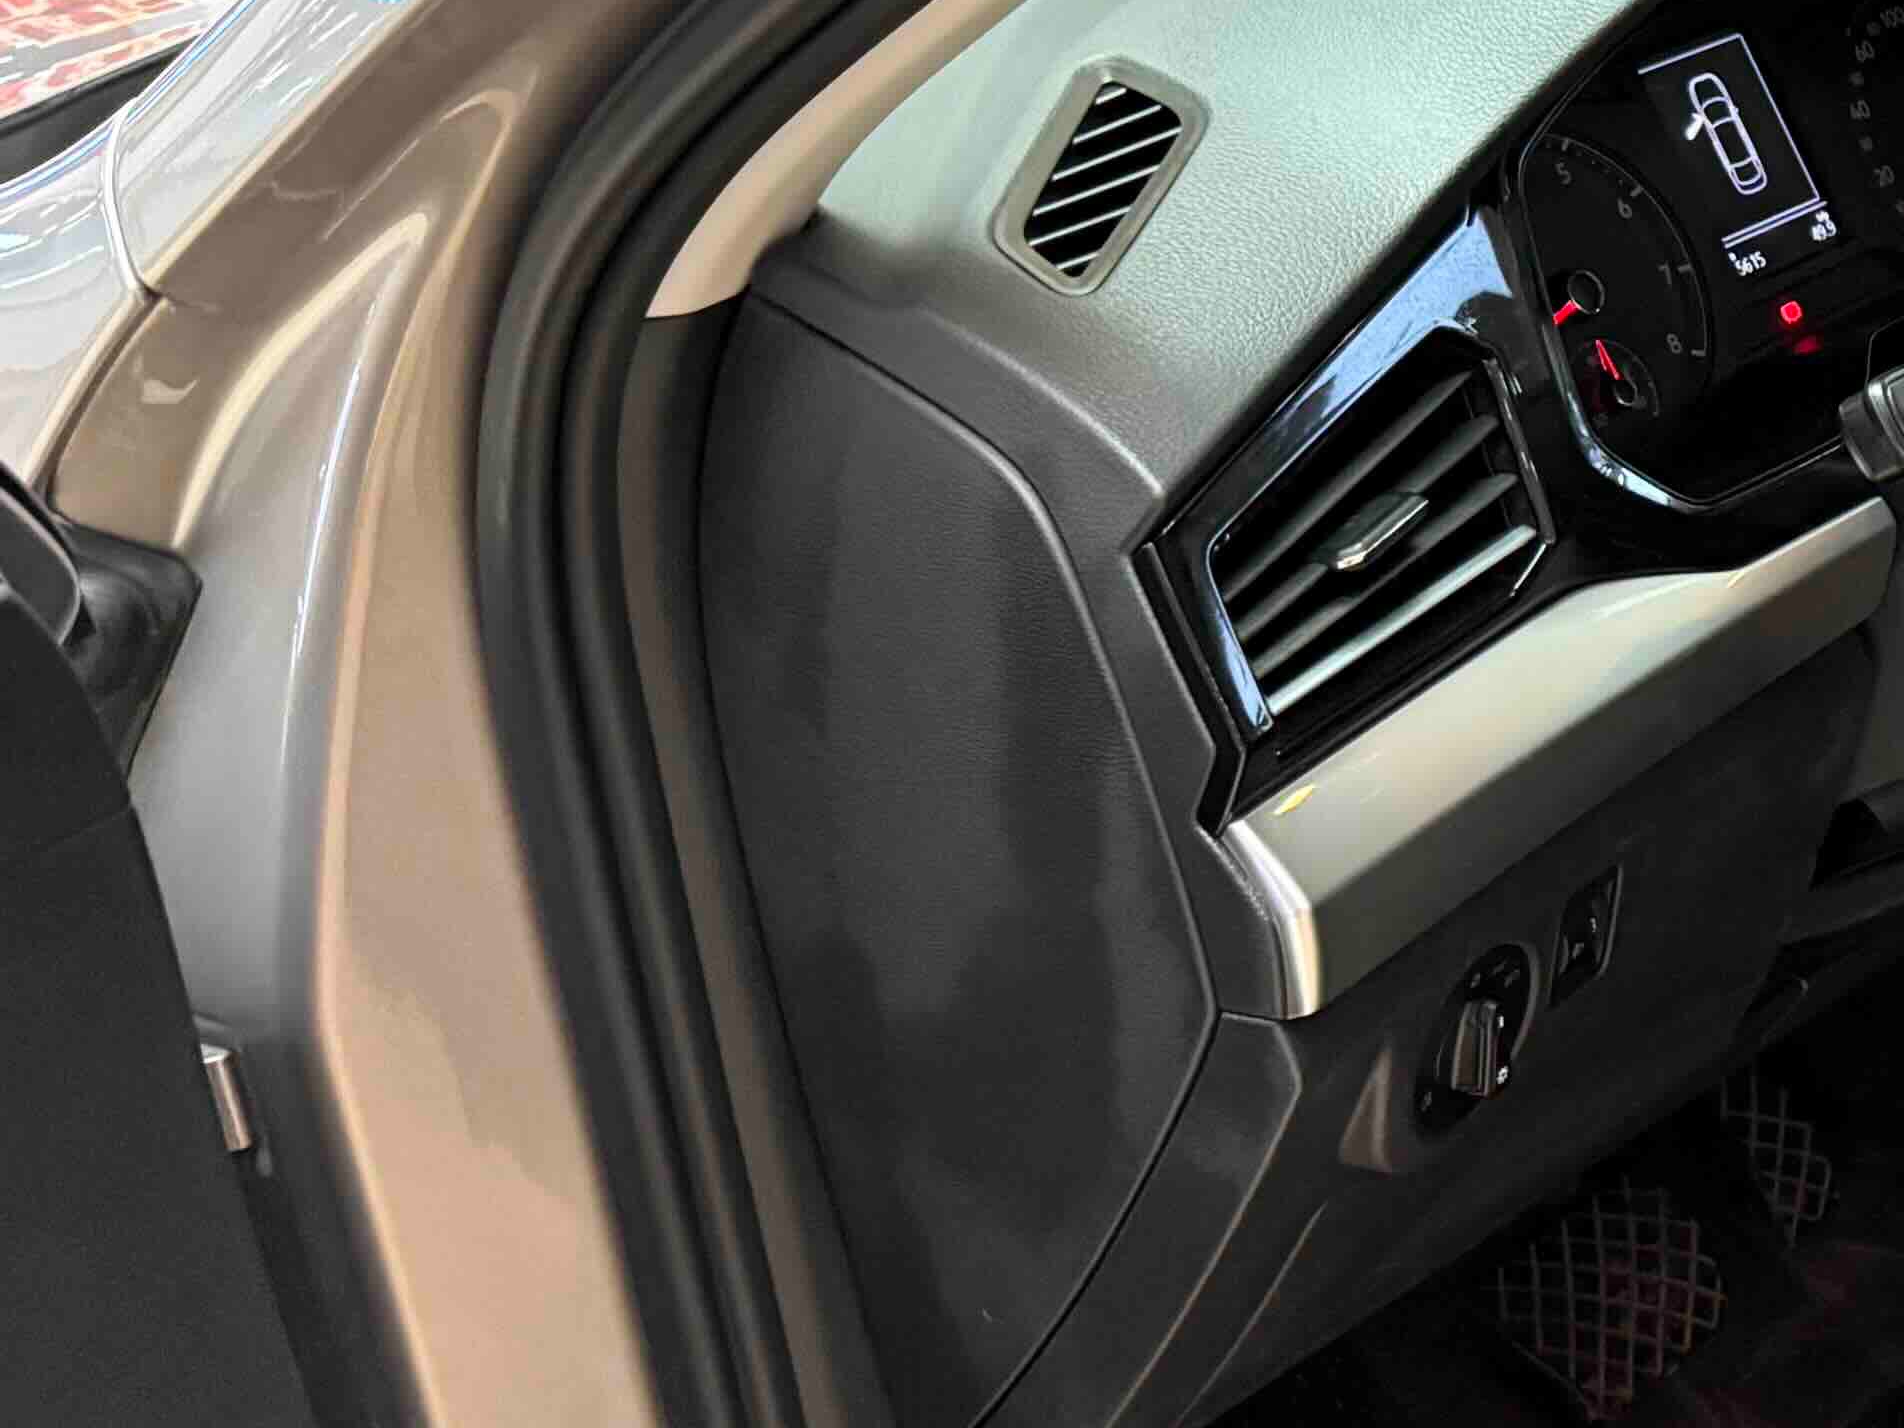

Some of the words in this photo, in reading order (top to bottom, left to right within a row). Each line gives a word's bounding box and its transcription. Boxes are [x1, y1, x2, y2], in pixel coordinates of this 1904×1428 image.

[1556, 161, 1571, 185] 5
[1617, 197, 1632, 219] 6
[1666, 333, 1683, 354] 8
